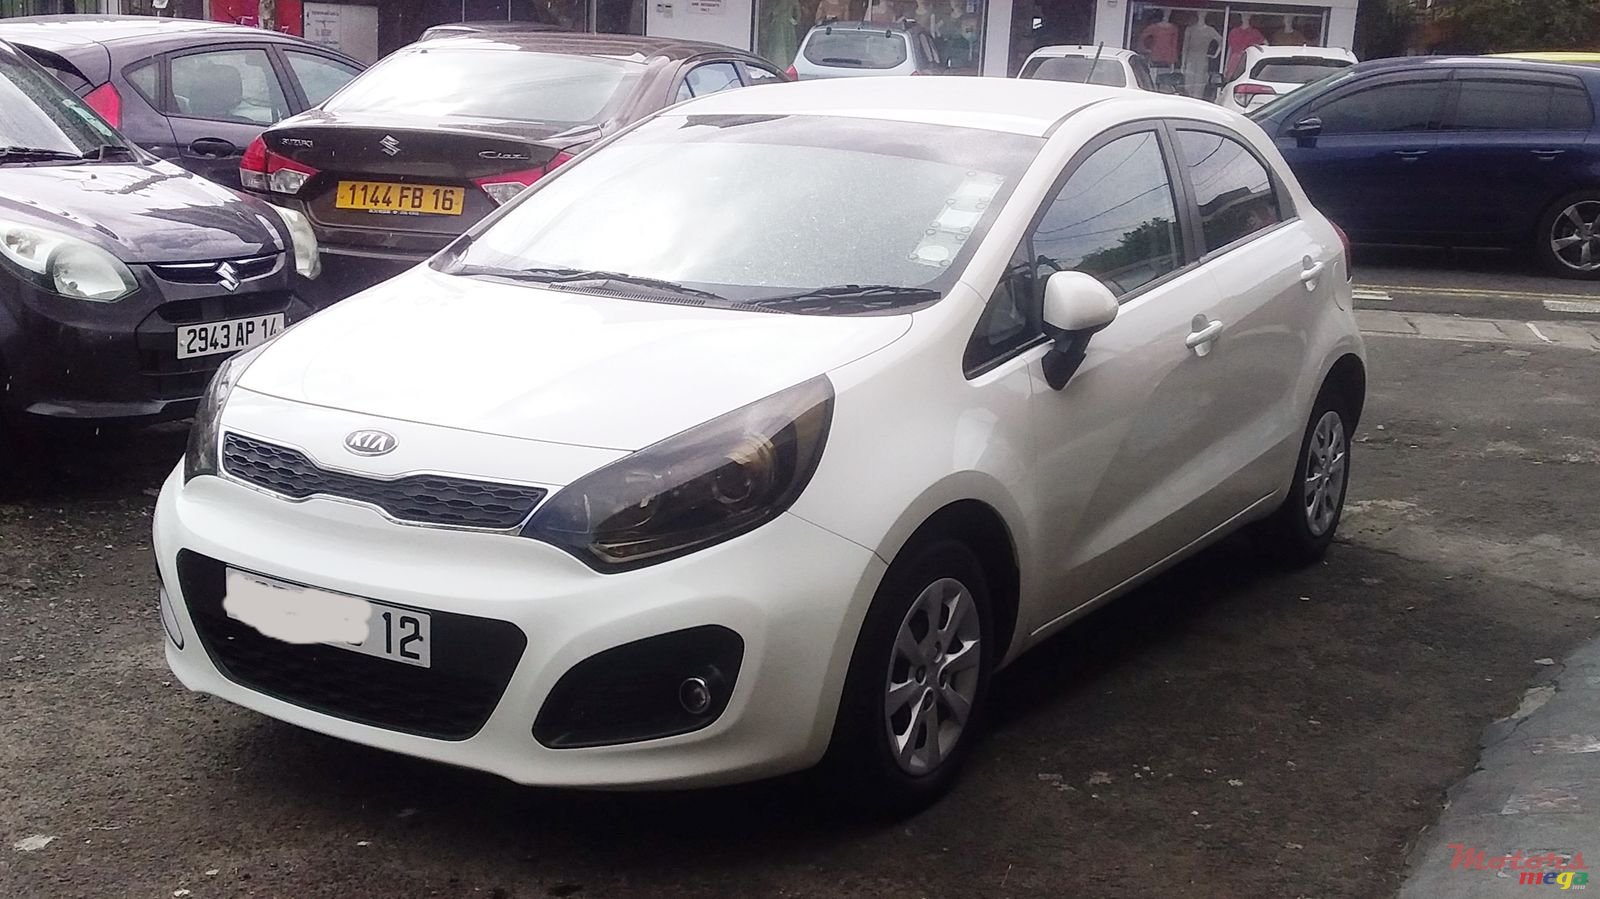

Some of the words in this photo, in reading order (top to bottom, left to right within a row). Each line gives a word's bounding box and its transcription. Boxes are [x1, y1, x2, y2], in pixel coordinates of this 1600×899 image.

[281, 137, 313, 148] SUZUKI
[349, 184, 392, 206] 1144
[398, 186, 424, 209] FB
[432, 188, 455, 211] 16
[187, 324, 230, 354] 2943
[235, 320, 255, 347] AP
[349, 431, 388, 451] KIA
[382, 612, 420, 660] 12
